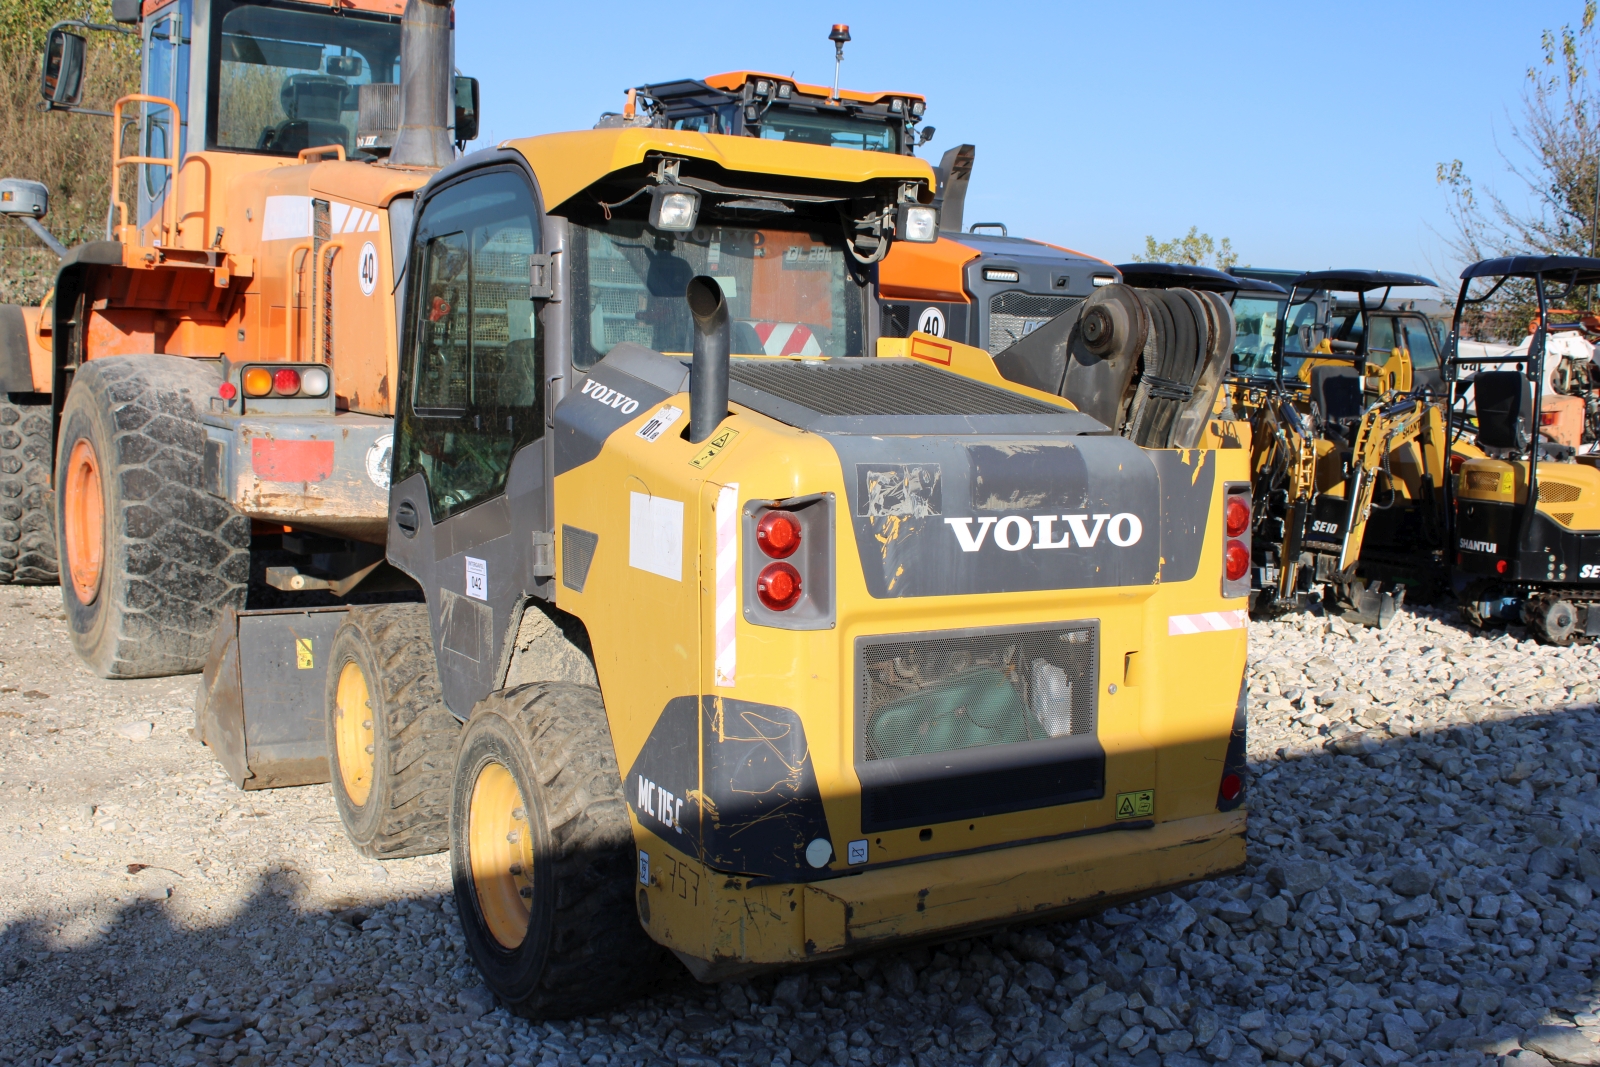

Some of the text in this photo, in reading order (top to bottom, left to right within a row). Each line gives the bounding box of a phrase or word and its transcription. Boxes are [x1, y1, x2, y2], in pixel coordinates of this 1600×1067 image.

[673, 227, 765, 247] VOLVO
[362, 252, 374, 285] 40
[923, 316, 939, 337] 40
[580, 378, 640, 415] VOLVO
[943, 512, 1143, 552] VOLVO
[1312, 520, 1338, 534] SE10
[1459, 538, 1498, 554] SHANTUI
[1579, 564, 1600, 579] SE
[471, 576, 482, 591] 042
[638, 774, 655, 817] MC
